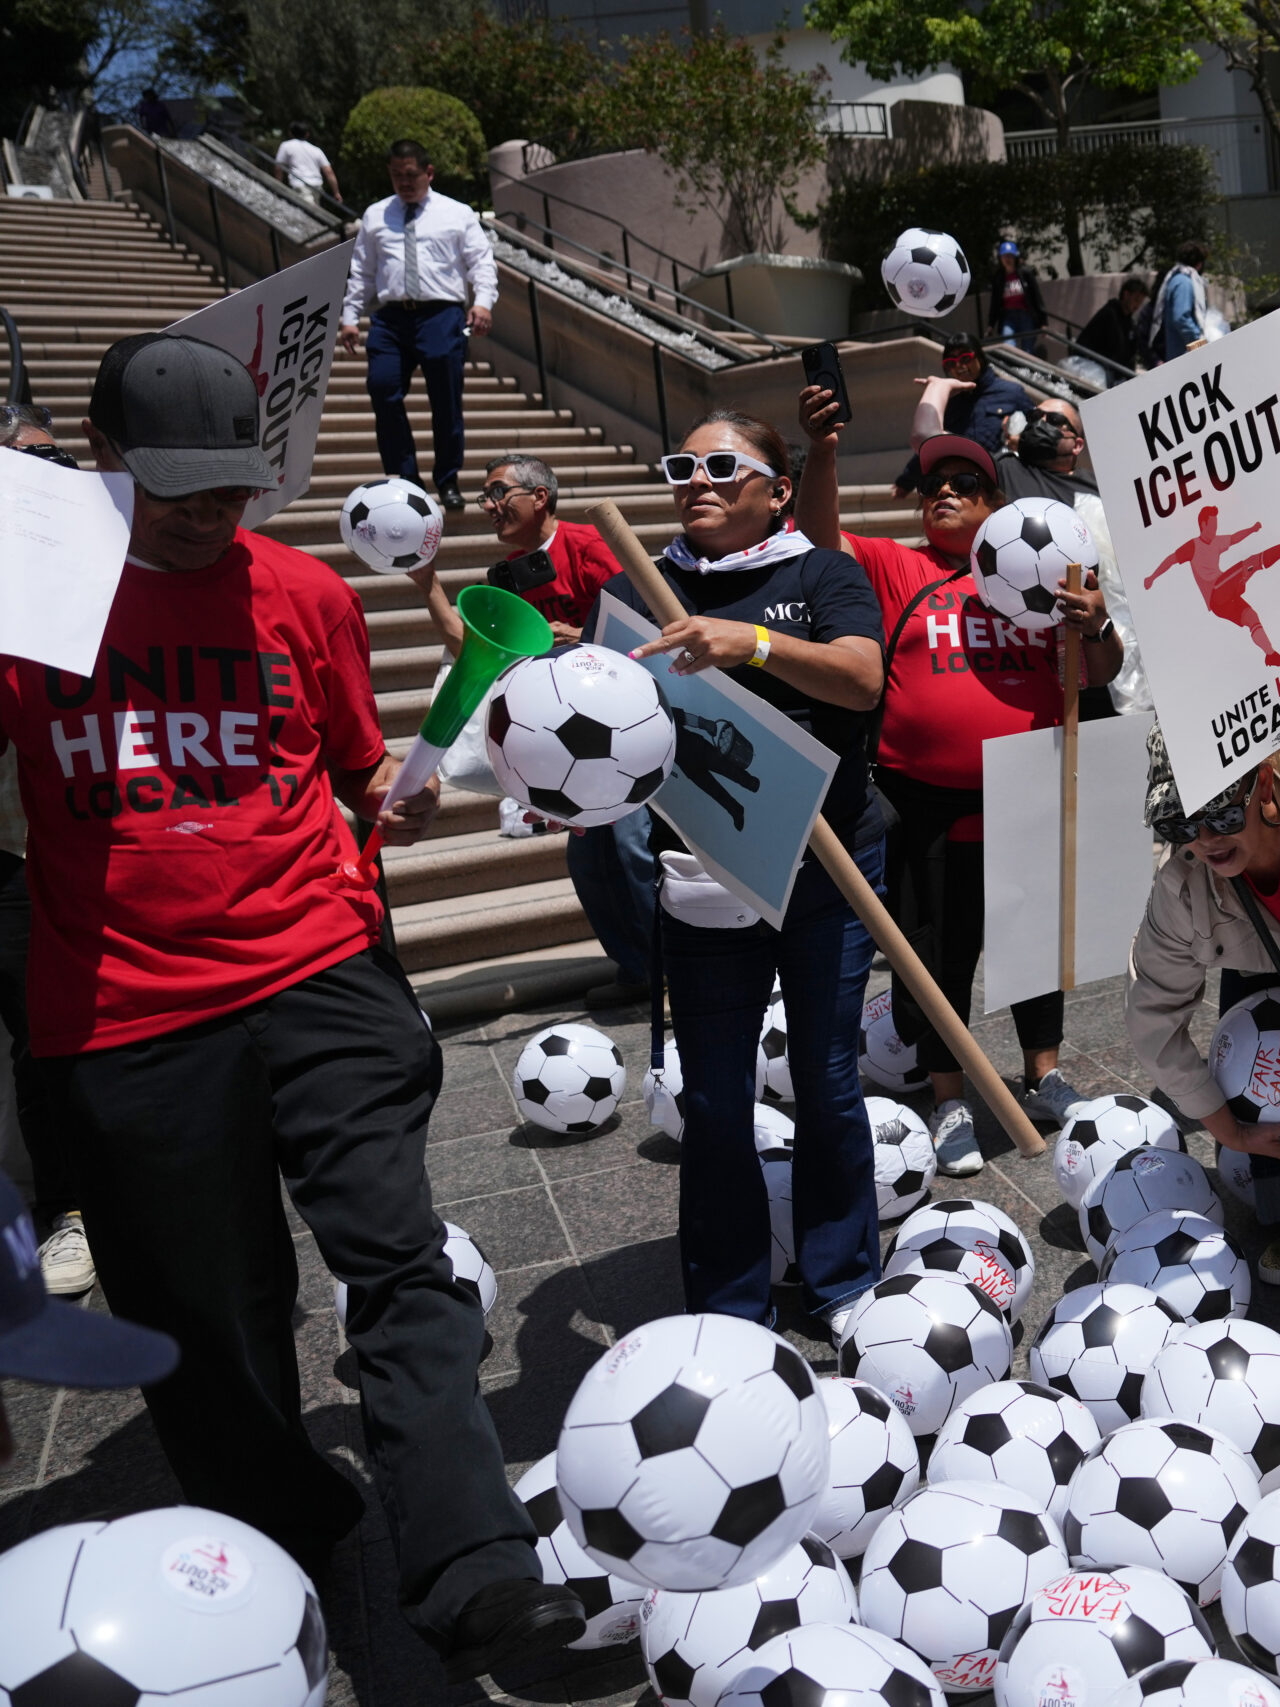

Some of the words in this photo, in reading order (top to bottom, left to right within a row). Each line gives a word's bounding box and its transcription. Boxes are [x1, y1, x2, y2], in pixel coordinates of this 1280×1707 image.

[274, 295, 308, 377] ICE
[295, 302, 330, 415] KICK
[1138, 363, 1235, 461] KICK
[1134, 451, 1202, 528] ICE
[45, 645, 294, 709] UNITE
[931, 652, 1036, 674] LOCAL
[1211, 684, 1271, 738] UNITE
[51, 711, 286, 778] HERE!
[65, 774, 239, 820] LOCAL
[261, 774, 297, 808] 11
[1251, 1047, 1275, 1099] FAIR
[972, 1240, 1016, 1294] GAMES
[973, 1267, 1008, 1308] FAIR
[1047, 1592, 1122, 1621] FAIR
[954, 1654, 997, 1674] FAI
